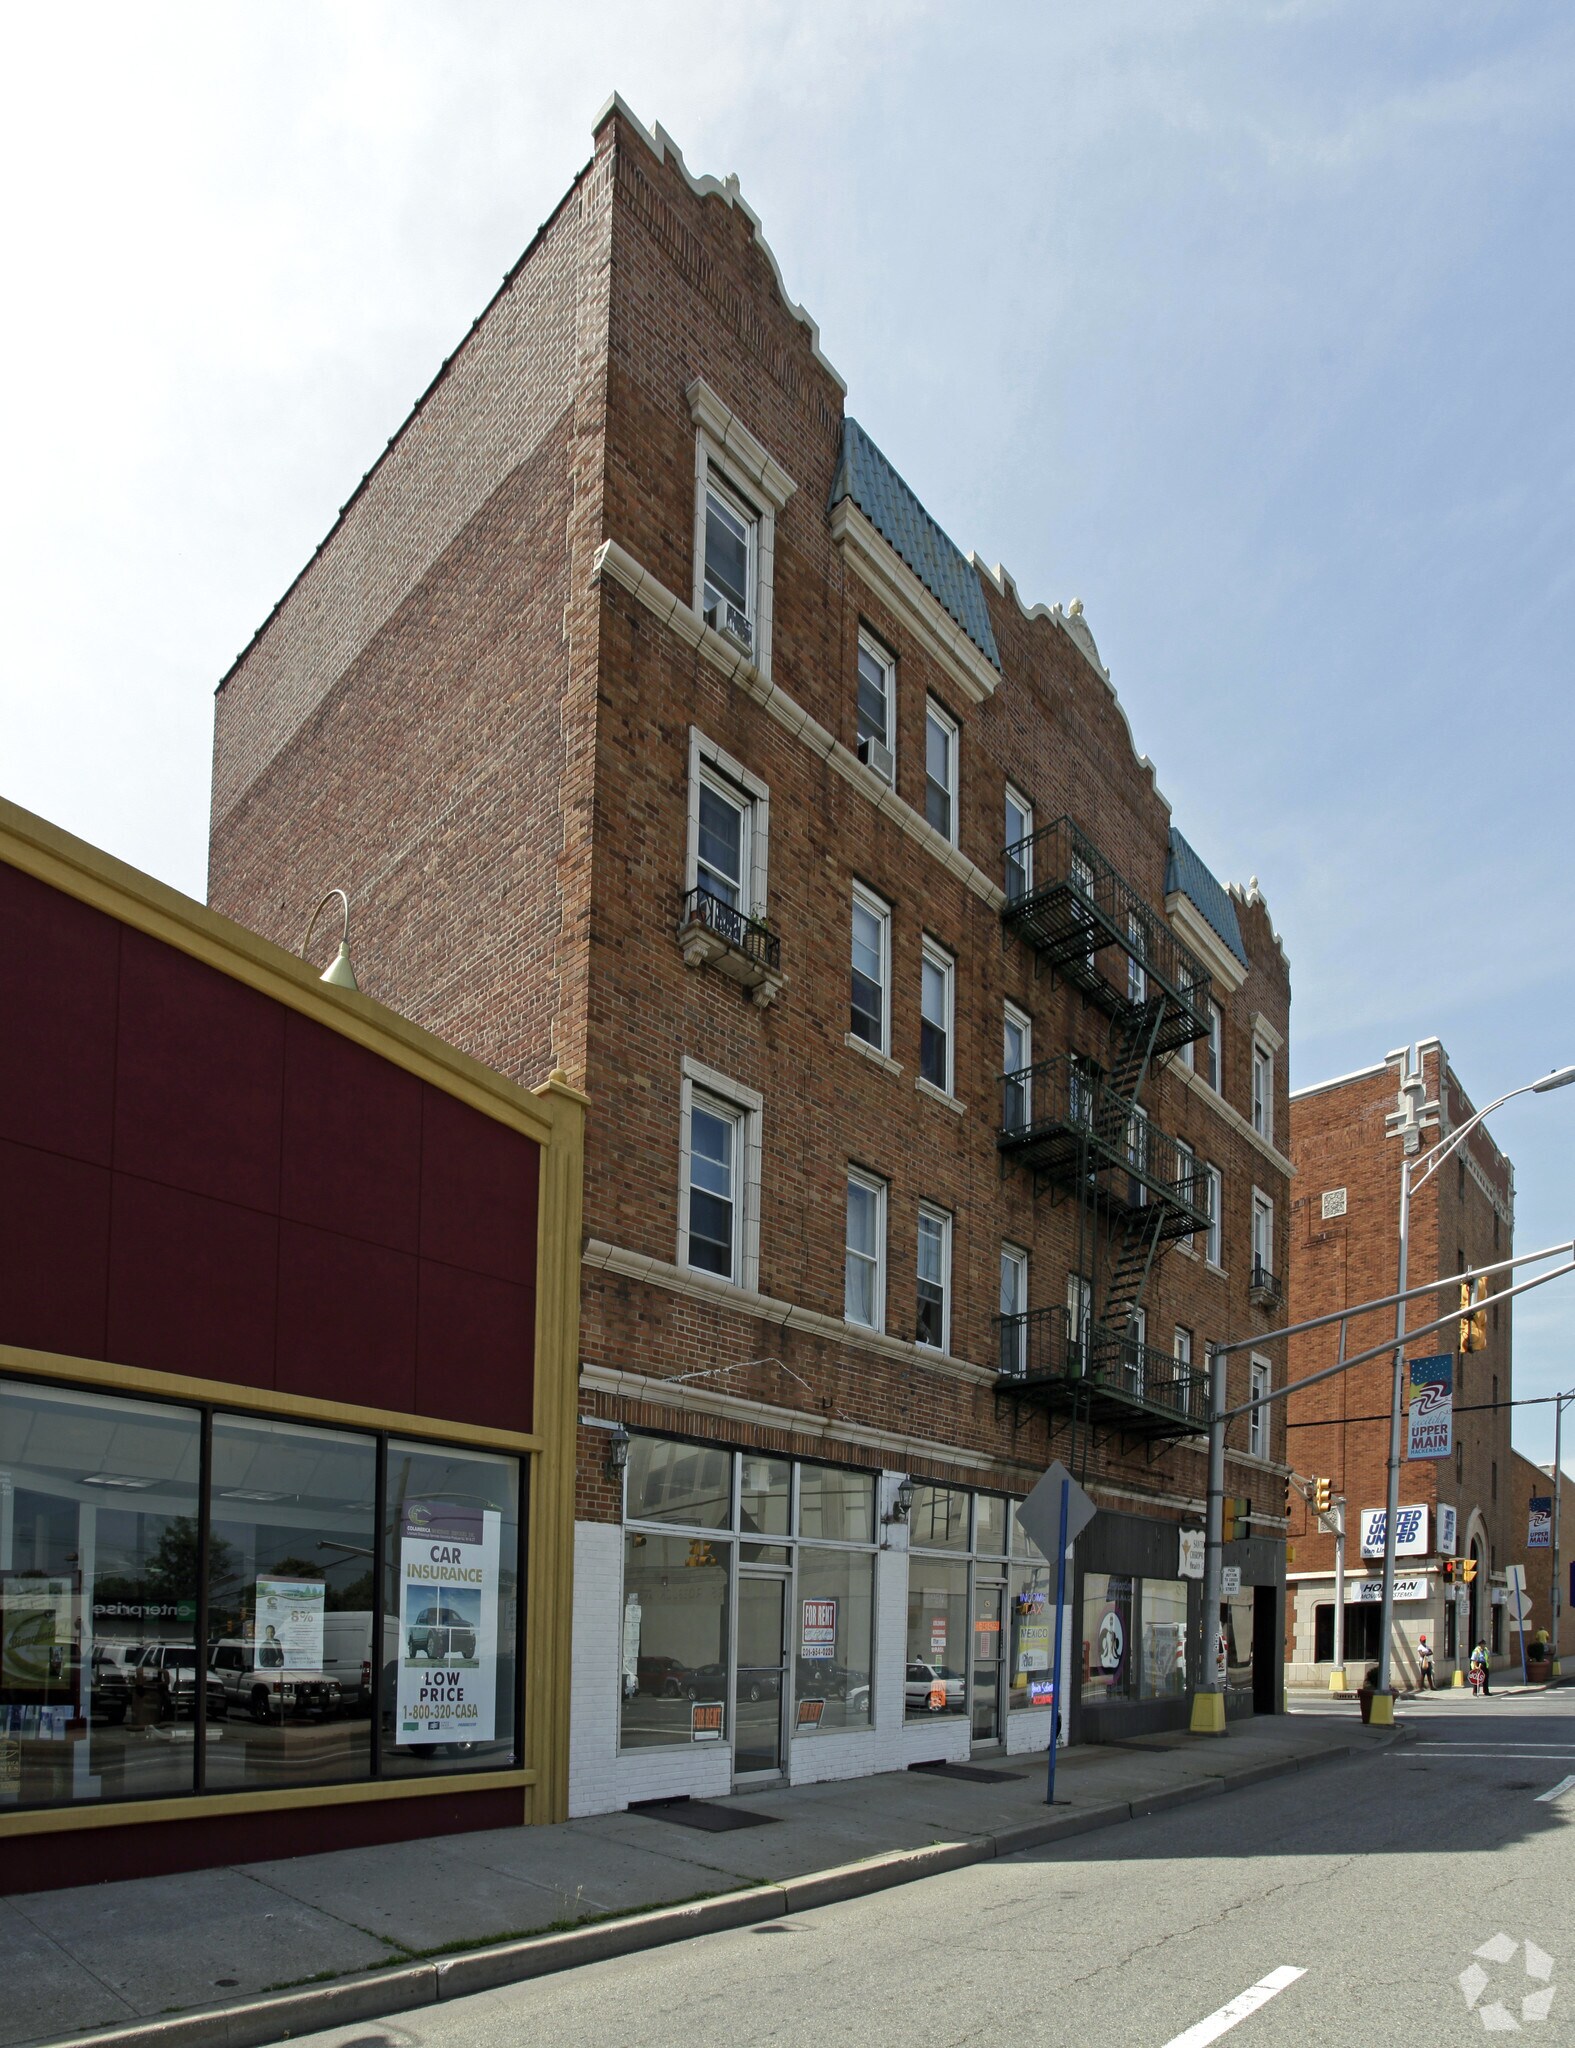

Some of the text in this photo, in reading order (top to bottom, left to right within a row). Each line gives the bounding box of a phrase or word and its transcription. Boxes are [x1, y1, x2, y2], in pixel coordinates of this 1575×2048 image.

[1411, 1424, 1448, 1437] UPPER
[1411, 1435, 1448, 1450] MAIN
[1410, 1447, 1448, 1455] HACKENSACK
[1368, 1520, 1419, 1535] UNTED
[430, 1545, 462, 1566] CAR
[407, 1563, 483, 1583] INSURANCE
[1020, 1592, 1047, 1603] INCOME
[805, 1605, 834, 1626] FOR RENT
[1024, 1603, 1043, 1614] TAX
[290, 1610, 314, 1623] 8%
[1020, 1628, 1048, 1639] MEXICO
[425, 1671, 461, 1686] LOW
[419, 1688, 464, 1702] PRICE
[403, 1704, 479, 1720] 1-800-320-CASA
[694, 1707, 722, 1730] FOR RENT
